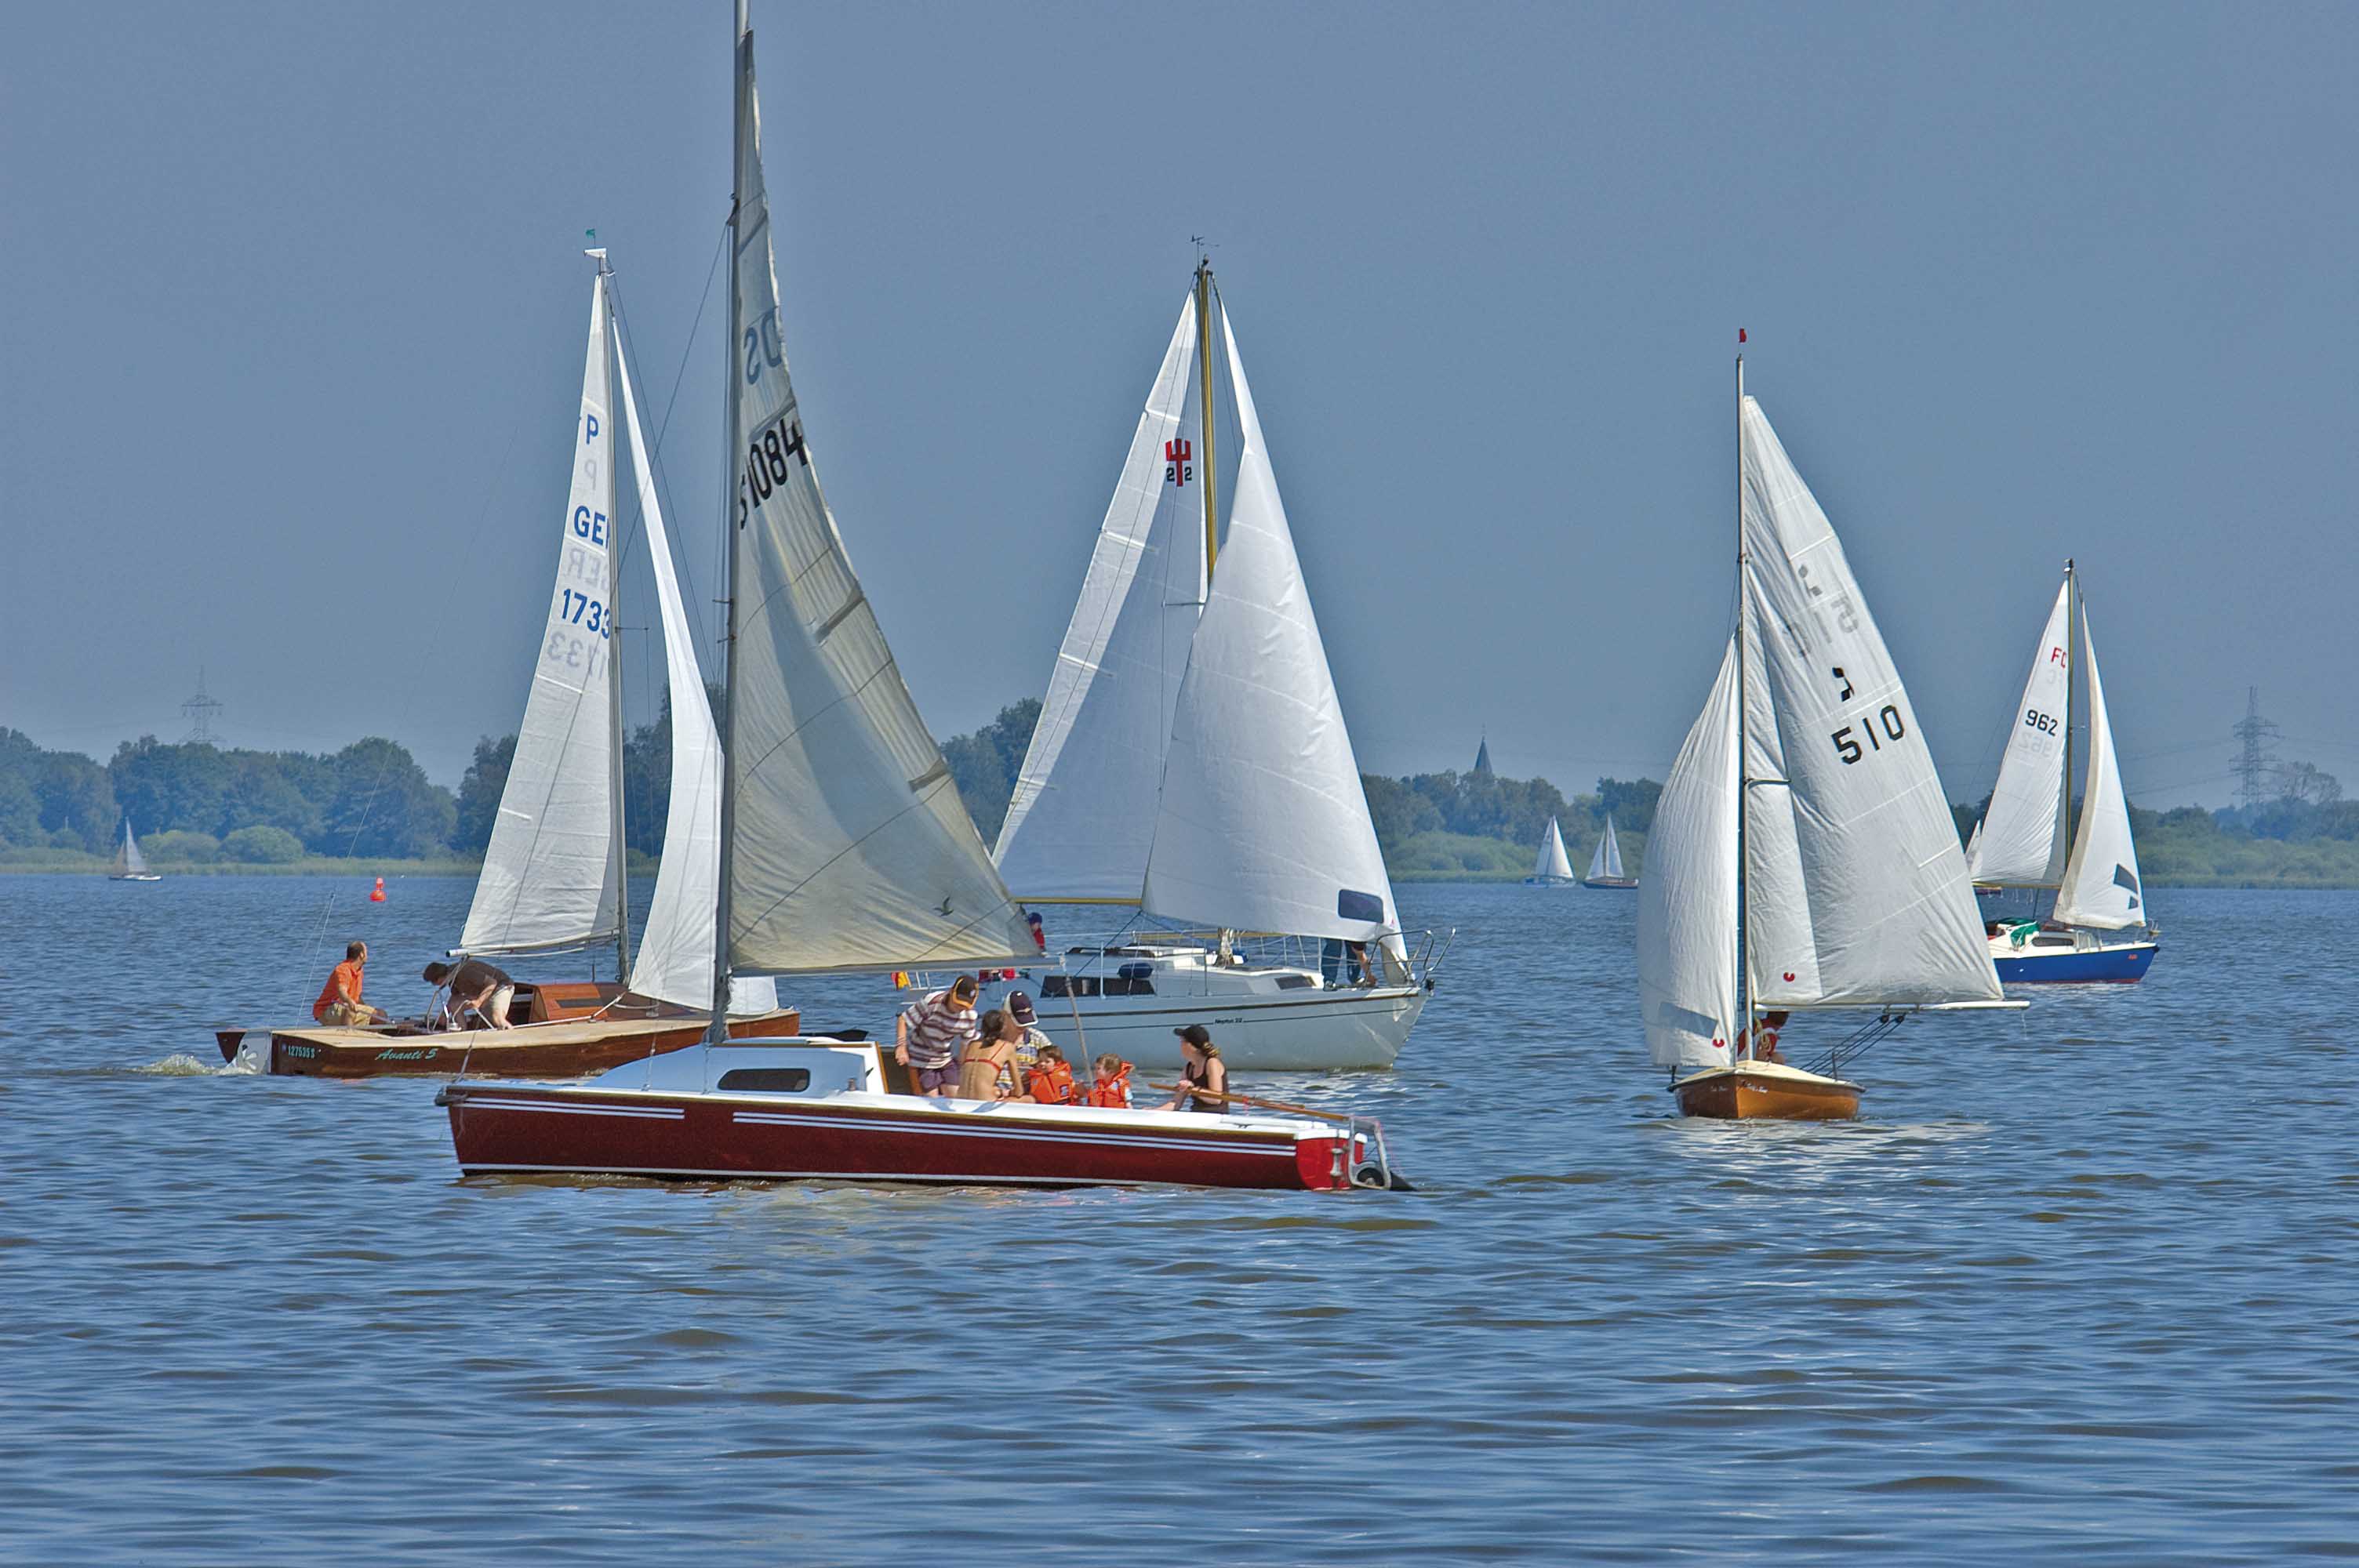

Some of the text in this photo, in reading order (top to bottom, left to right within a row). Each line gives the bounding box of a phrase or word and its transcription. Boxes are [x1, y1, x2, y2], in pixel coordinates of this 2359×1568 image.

[586, 414, 598, 445] P
[1166, 466, 1192, 481] 2 2
[574, 506, 609, 549] GE
[562, 589, 609, 639] 1733
[1830, 705, 1905, 764] 510
[2025, 710, 2058, 736] 962
[425, 1048, 438, 1060] 5
